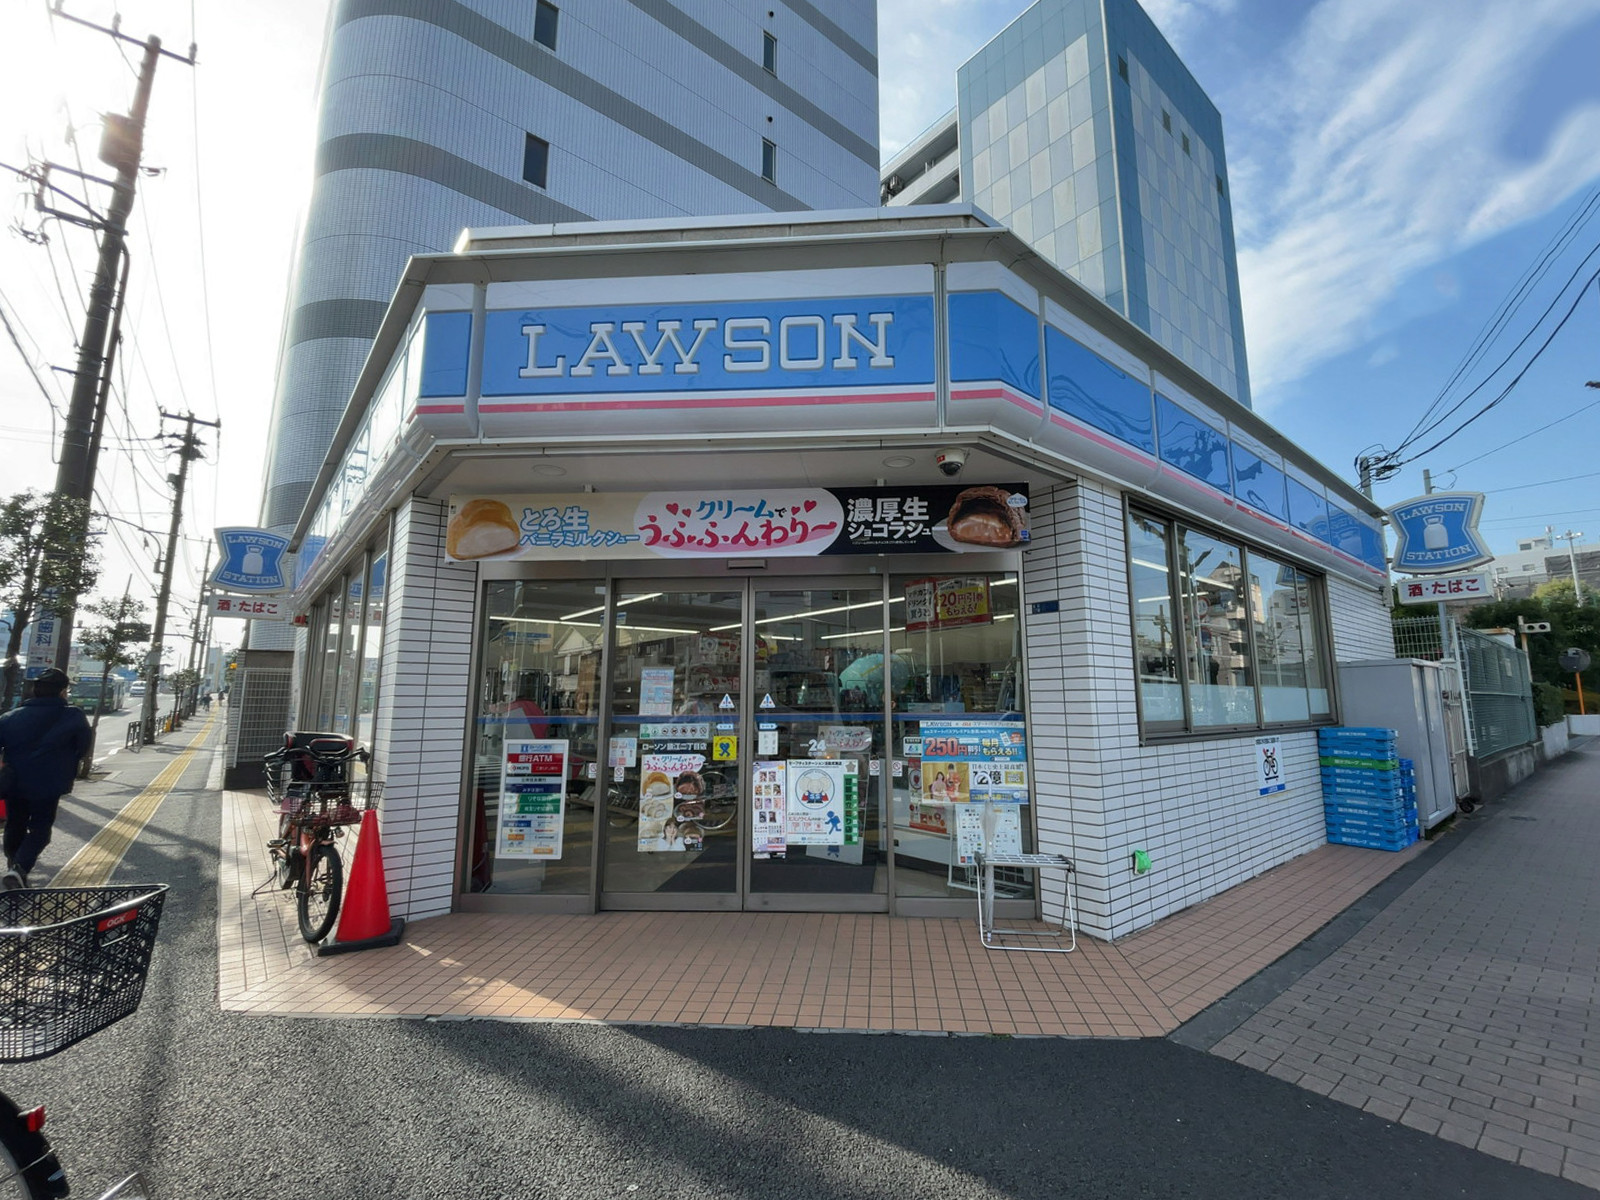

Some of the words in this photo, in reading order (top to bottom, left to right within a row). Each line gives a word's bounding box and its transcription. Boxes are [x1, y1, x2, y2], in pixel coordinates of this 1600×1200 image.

[518, 312, 896, 379] LAWSON
[847, 497, 930, 522] 濃厚生
[1400, 502, 1466, 521] LAWSON
[520, 505, 590, 532] とろ生
[848, 521, 949, 539] ショコラシュー
[226, 535, 284, 549] LAWSON
[519, 531, 641, 548] バニラミルクシュー
[1406, 543, 1472, 560] STATION
[222, 571, 279, 584] STATION
[1408, 579, 1480, 597] 酒・たばこ
[217, 599, 278, 614] 酒・たばこ
[808, 738, 827, 752] 24
[518, 754, 553, 763] 銀行ATM
